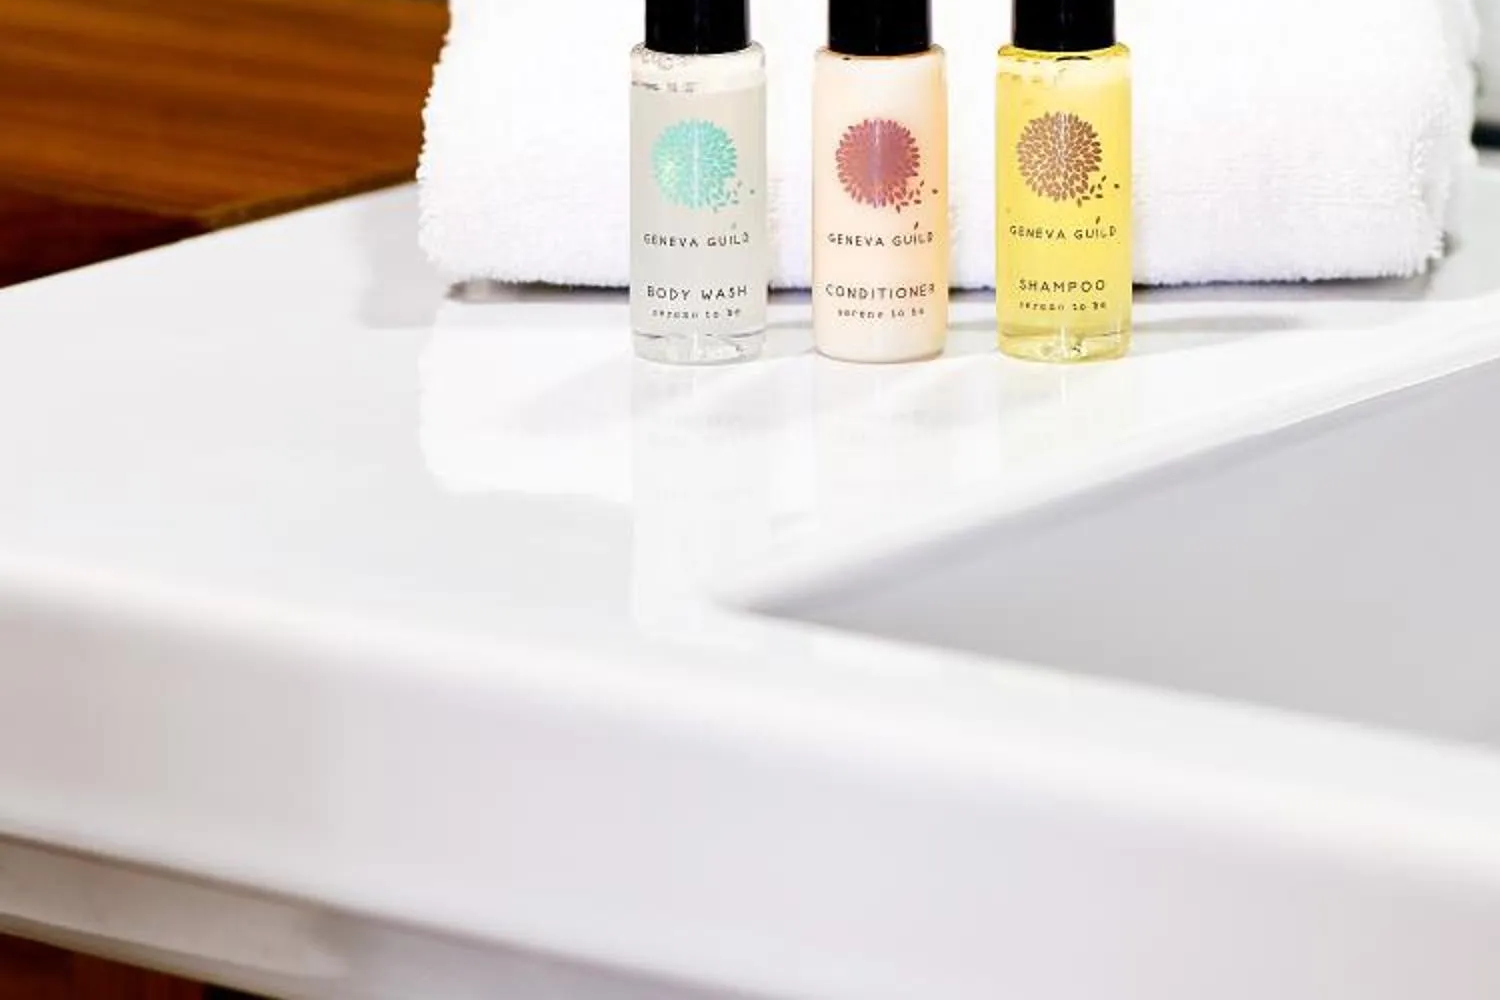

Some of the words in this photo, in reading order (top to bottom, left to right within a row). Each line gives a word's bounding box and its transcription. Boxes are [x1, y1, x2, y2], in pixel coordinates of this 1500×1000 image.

[643, 233, 699, 248] GENEVA
[707, 231, 749, 248] GUILD
[827, 232, 885, 247] GENEVA
[891, 231, 934, 247] GUILD
[1009, 225, 1067, 240] GENEVA
[1073, 225, 1117, 240] GUILD
[647, 285, 691, 301] BODY
[700, 284, 748, 301] WASH
[825, 283, 935, 300] CONDITIONER
[1019, 279, 1105, 293] SHAMPOO
